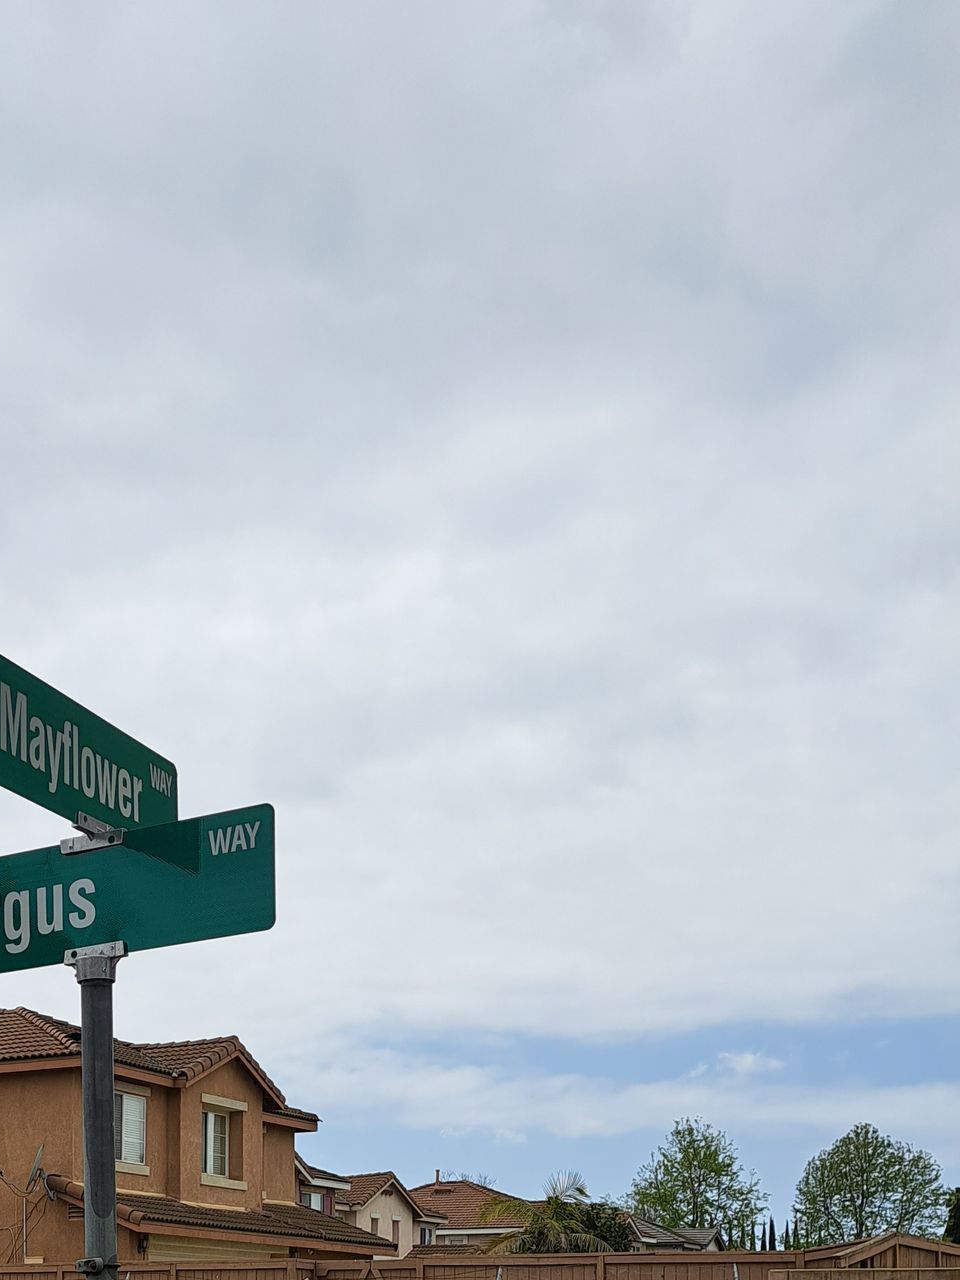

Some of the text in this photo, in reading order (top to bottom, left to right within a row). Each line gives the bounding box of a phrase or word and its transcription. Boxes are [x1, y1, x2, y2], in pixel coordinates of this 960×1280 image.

[0, 680, 173, 822] Mayflower WAY
[208, 821, 261, 856] WAY
